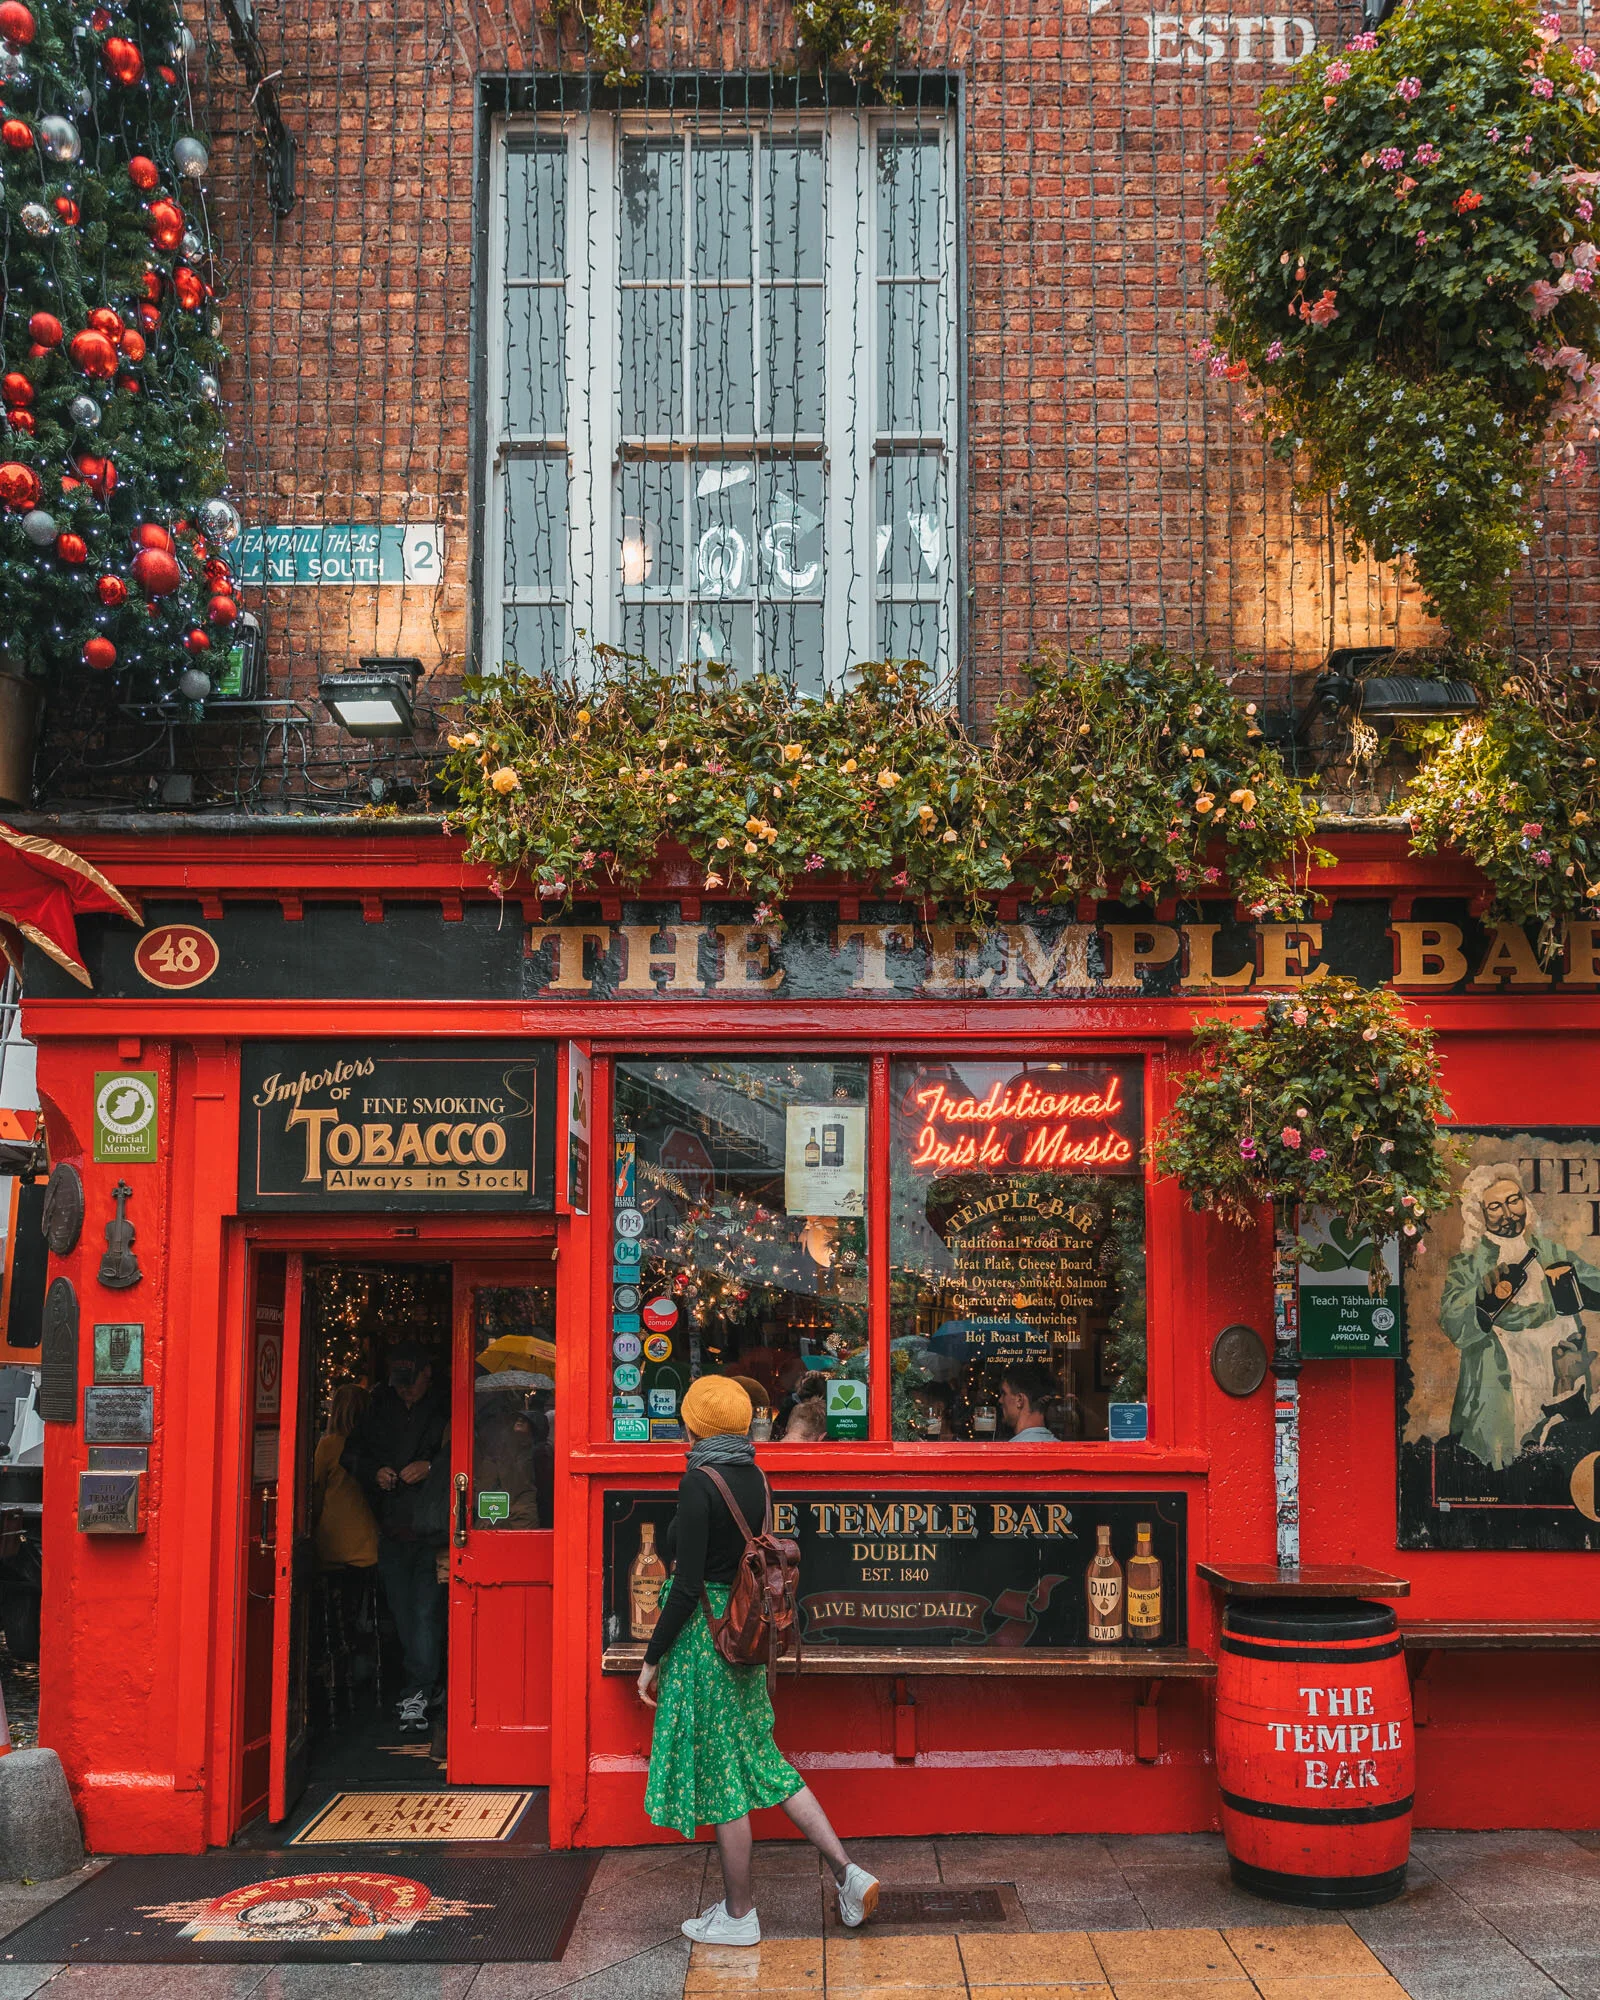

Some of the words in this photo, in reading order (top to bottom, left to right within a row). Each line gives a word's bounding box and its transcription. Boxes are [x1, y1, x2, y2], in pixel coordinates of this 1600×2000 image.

[1144, 15, 1317, 65] ESTD
[235, 533, 319, 553] TEAMPAILL
[326, 534, 380, 553] THEAS
[414, 541, 433, 569] 2
[240, 559, 297, 577] LANE
[308, 558, 384, 577] SOUTH
[149, 934, 200, 972] 48
[528, 924, 786, 990] THE
[836, 922, 1332, 989] TEMPLE
[102, 1084, 114, 1096] THE
[116, 1080, 149, 1096] IRELAND
[252, 1056, 375, 1108] Importers
[329, 1087, 351, 1100] OF
[916, 1076, 1121, 1122] Traditional
[362, 1097, 408, 1114] FINE
[412, 1096, 506, 1115] SMOKING
[107, 1134, 143, 1144] Official
[285, 1108, 507, 1183] TOBACCO
[911, 1126, 1004, 1165] Irish
[1024, 1125, 1131, 1164] Music
[104, 1144, 147, 1153] Member
[330, 1170, 413, 1189] Always
[427, 1172, 446, 1187] in
[458, 1170, 524, 1187] Stock
[1007, 1179, 1028, 1189] The
[1518, 1158, 1600, 1195] TE
[945, 1192, 1040, 1233] TEMPLE
[1050, 1197, 1093, 1234] BAR
[1002, 1215, 1017, 1223] Est.
[1019, 1215, 1036, 1223] 1840
[944, 1235, 1020, 1249] Traditional
[1025, 1235, 1058, 1249] Food
[1063, 1236, 1094, 1249] Fare
[953, 1258, 980, 1270] Meat
[984, 1258, 1015, 1272] Plate,
[1018, 1257, 1057, 1270] Cheese
[1060, 1257, 1093, 1270] Board
[939, 1276, 968, 1288] Fresh
[972, 1276, 1015, 1292] Oysters,
[1066, 1276, 1107, 1288] Salmon
[953, 1294, 1017, 1307] Charcuterie
[1022, 1294, 1056, 1309] Meats,
[1060, 1294, 1094, 1307] Olives
[1310, 1296, 1338, 1306] Teach
[1341, 1295, 1389, 1306] Tábhairne
[969, 1312, 1011, 1325] Toasted
[1014, 1312, 1077, 1325] Sandwiches
[1340, 1308, 1359, 1318] Pub
[965, 1331, 986, 1344] Hot
[990, 1331, 1020, 1343] Roast
[1025, 1331, 1050, 1343] Beef
[1053, 1331, 1081, 1343] Rolls
[1330, 1333, 1370, 1341] APPROVED
[618, 1343, 636, 1352] PPI
[653, 1394, 670, 1403] tax
[653, 1404, 673, 1412] free
[89, 1494, 126, 1502] TEMPLE
[810, 1503, 978, 1539] TEMPLE
[990, 1503, 1079, 1540] BAR
[852, 1543, 937, 1562] DUBLIN
[861, 1567, 894, 1582] EST.
[900, 1567, 930, 1582] 1840
[1090, 1581, 1119, 1597] D.W.D.
[1128, 1591, 1160, 1601] JAMESON
[812, 1602, 855, 1619] LIVE
[862, 1603, 918, 1619] MUSIC
[924, 1602, 977, 1618] DAILY
[1094, 1627, 1117, 1639] D.W.D.
[1299, 1686, 1375, 1717] THE
[1267, 1721, 1402, 1753] TEMPLE
[1304, 1759, 1380, 1789] BAR
[394, 1797, 473, 1808] THE
[335, 1808, 508, 1822] TEMPLE
[366, 1822, 453, 1834] BAR
[220, 1887, 270, 1910] THE
[271, 1875, 399, 1889] TEMPLE
[392, 1884, 417, 1908] BAR
